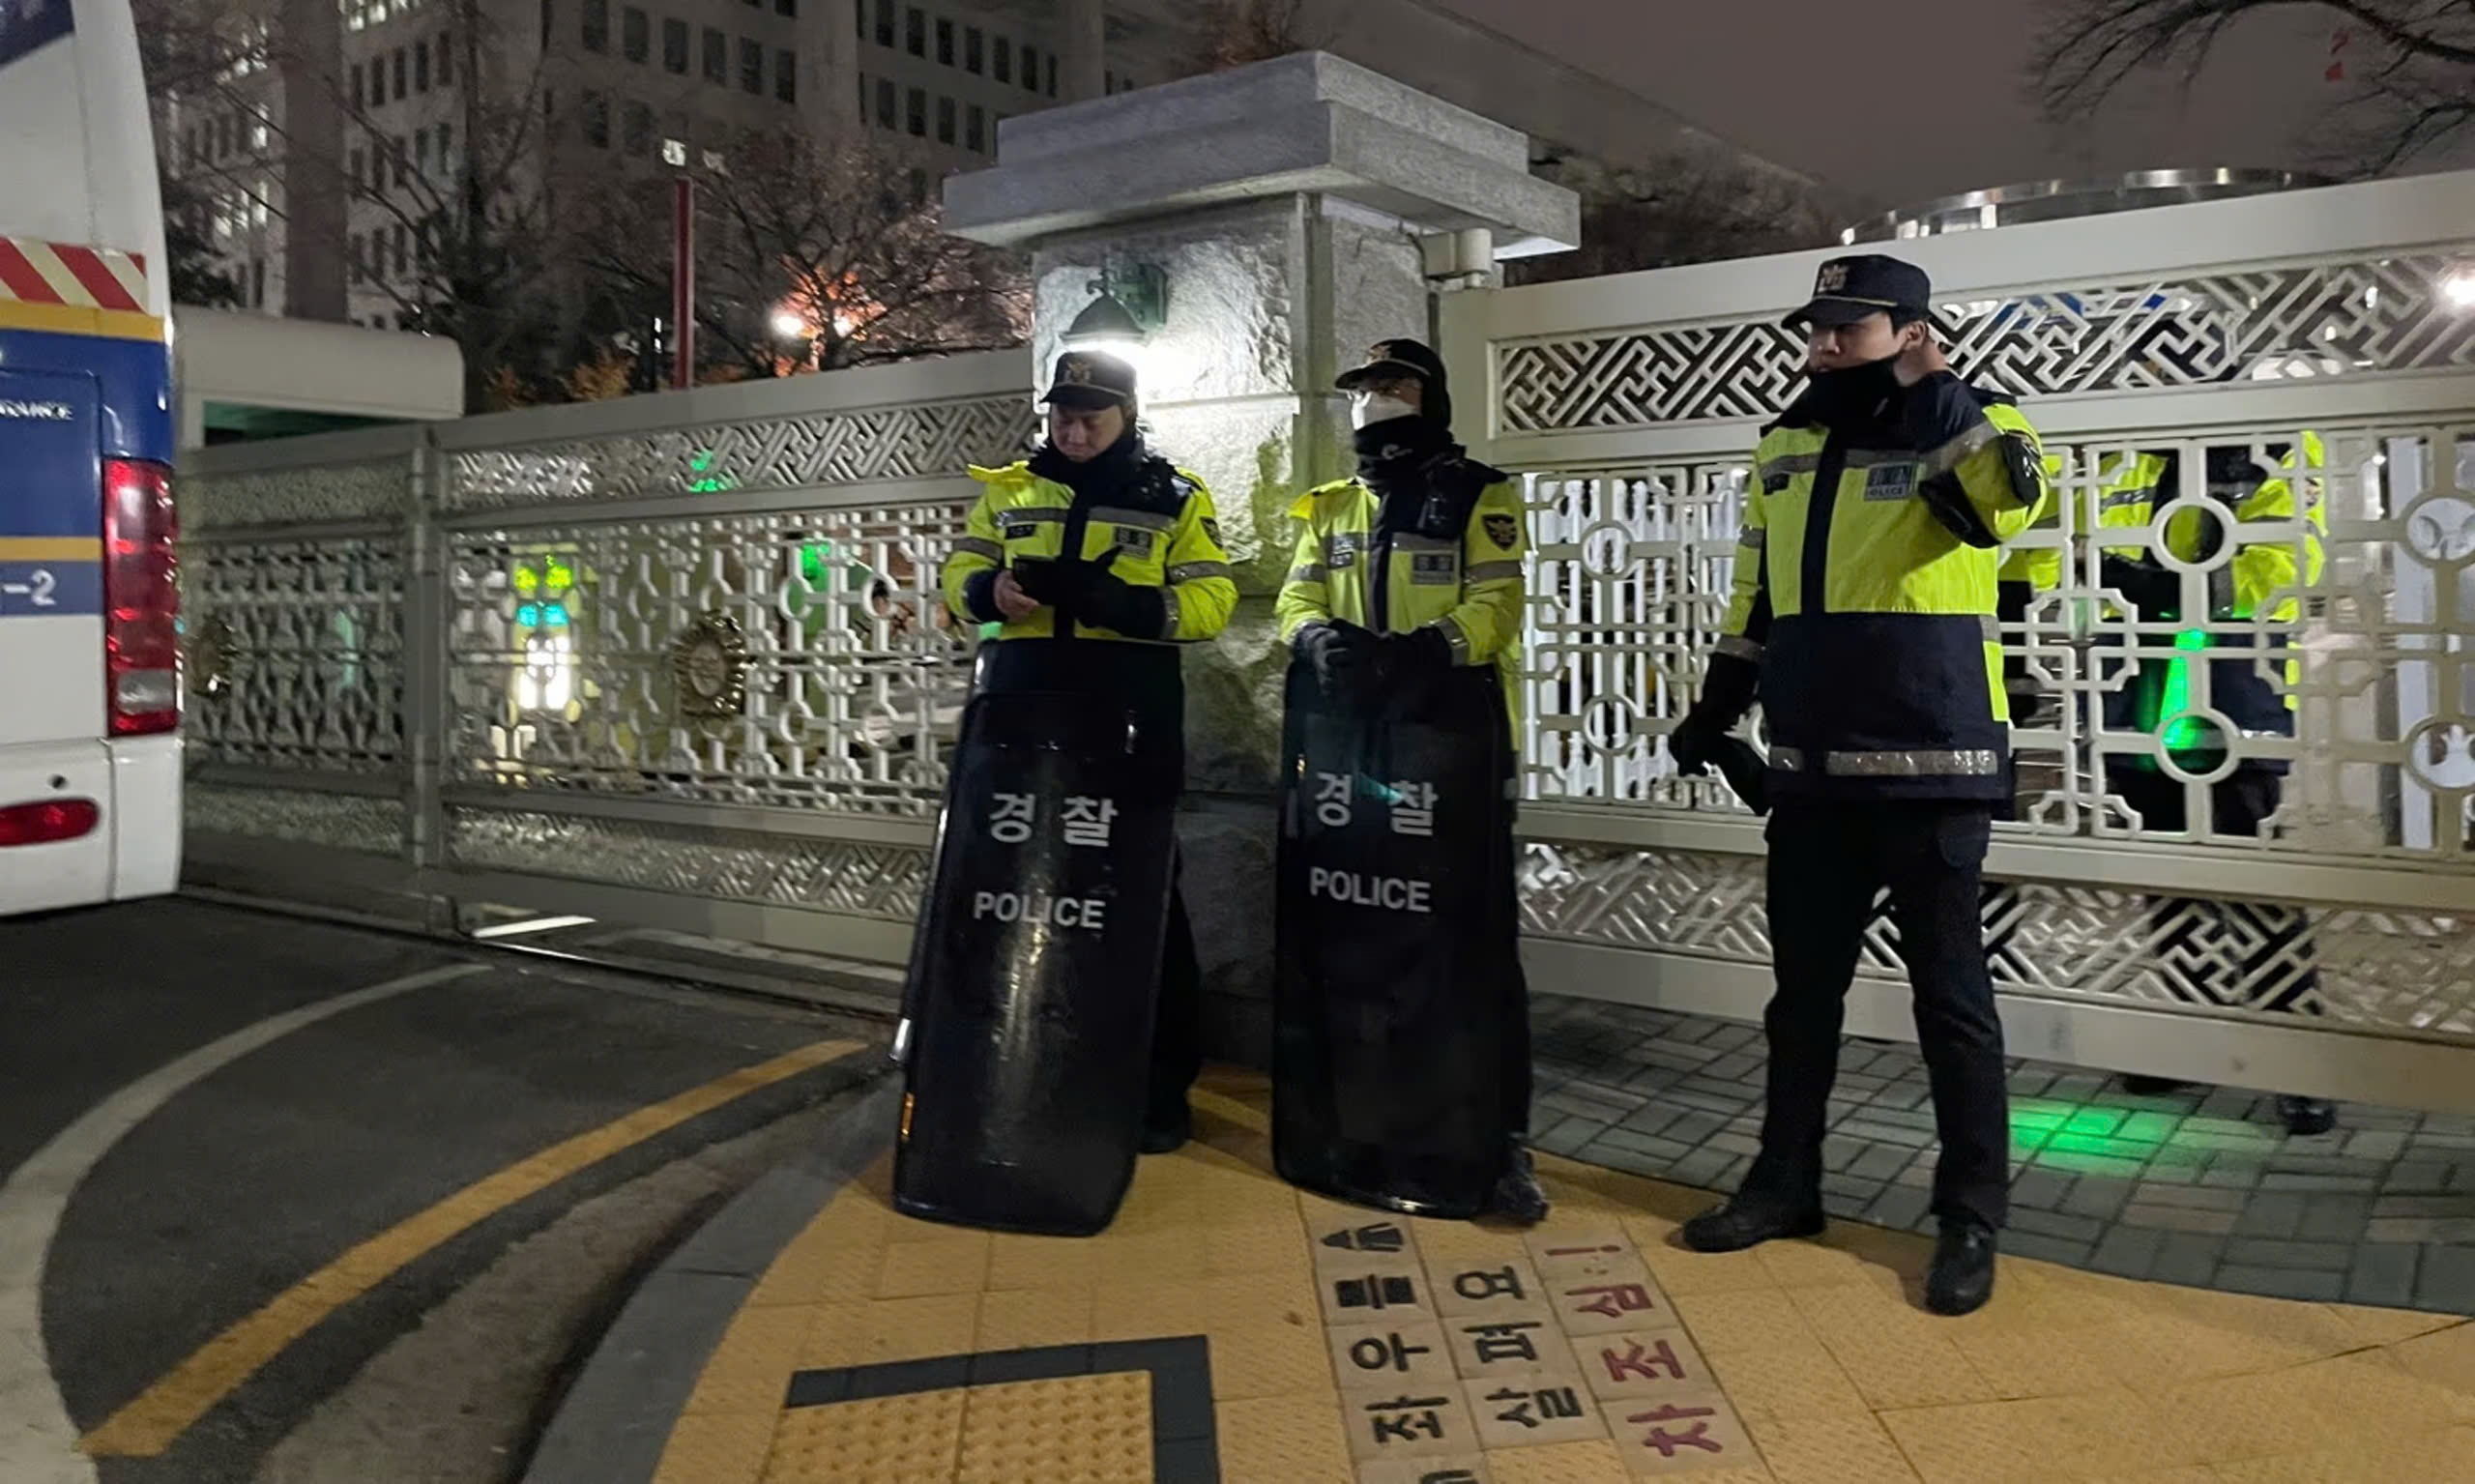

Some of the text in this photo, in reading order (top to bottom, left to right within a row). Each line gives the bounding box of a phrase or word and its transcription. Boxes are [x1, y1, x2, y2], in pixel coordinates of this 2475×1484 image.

[974, 891, 1106, 929] POLICE
[1310, 865, 1432, 913] POLICE
[1454, 1265, 1585, 1429] 살펴요
